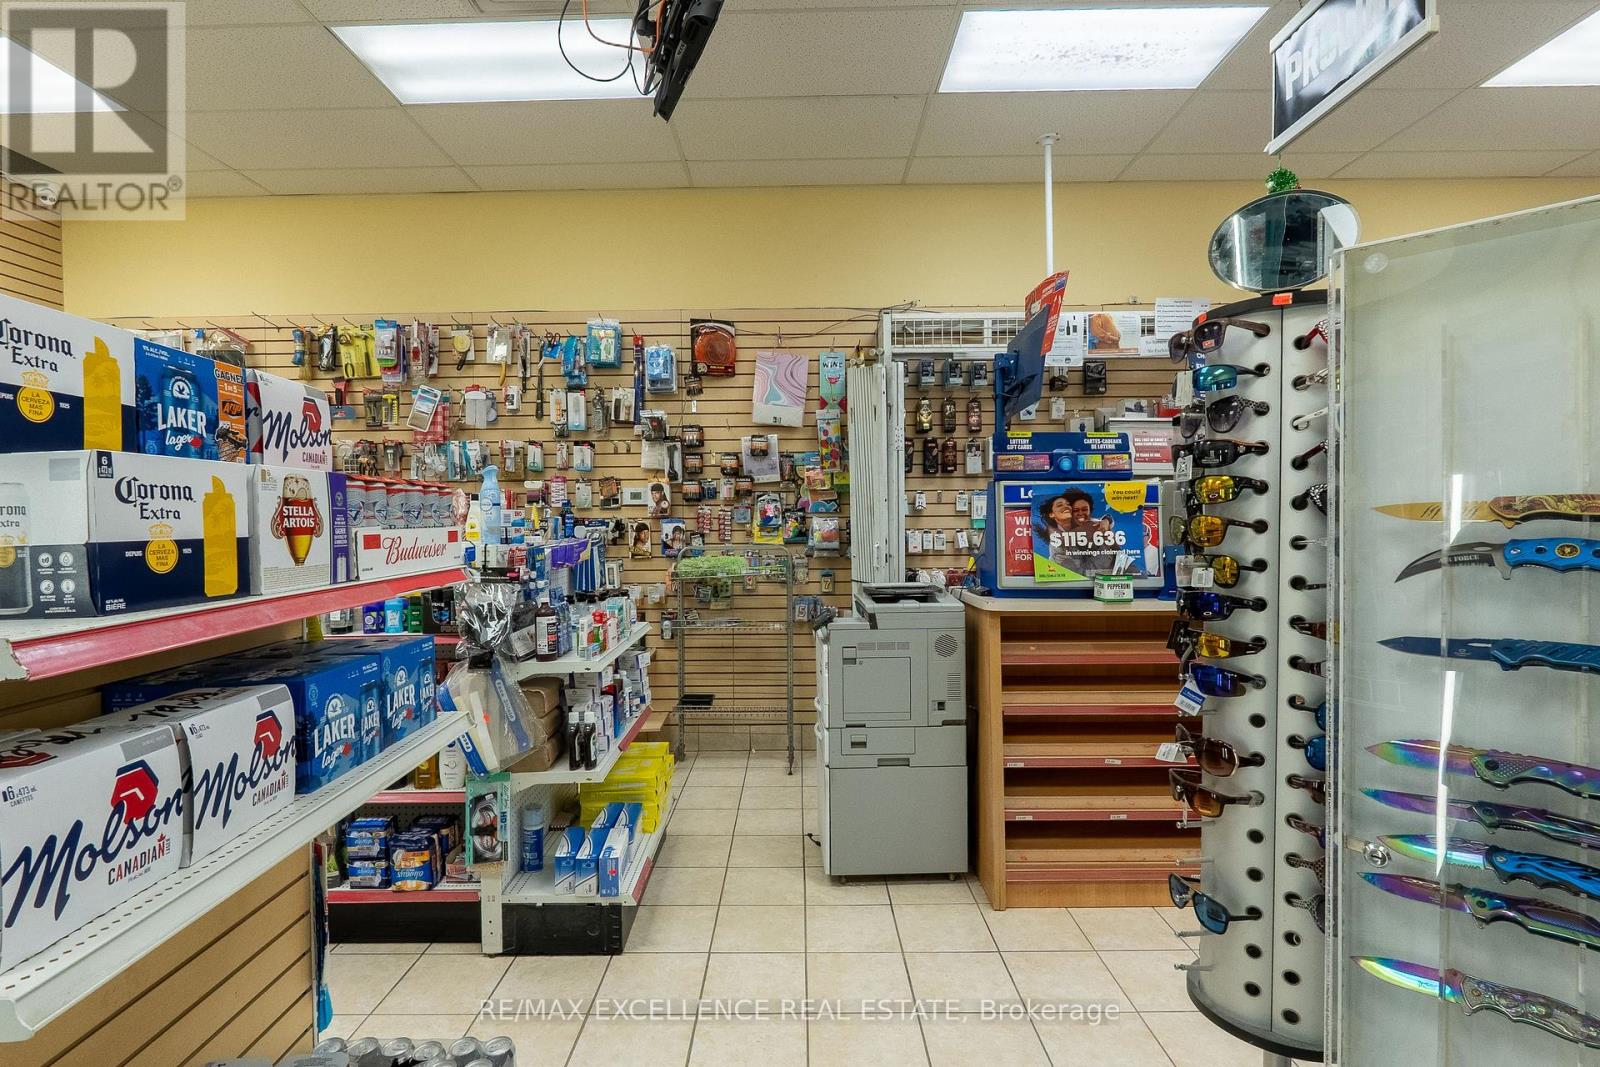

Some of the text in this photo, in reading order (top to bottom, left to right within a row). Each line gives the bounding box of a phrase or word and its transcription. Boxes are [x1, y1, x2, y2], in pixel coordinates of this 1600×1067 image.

[11, 346, 58, 372] Extra
[214, 368, 245, 385] GAGNEZ
[21, 396, 50, 405] CERVEZA
[157, 403, 207, 438] LAKER
[166, 430, 195, 451] lager
[262, 409, 332, 464] Molson
[101, 456, 108, 465] 6
[302, 451, 325, 465] CANADIAN
[115, 475, 194, 508] Corona
[0, 505, 26, 516] rona
[139, 502, 181, 520] Extra
[282, 506, 314, 516] STELLA
[0, 519, 20, 528] xtra
[282, 517, 315, 528] ARTOIS
[382, 536, 447, 565] Budweiser
[1050, 530, 1126, 549] $115,636
[1072, 549, 1100, 557] winnings
[387, 683, 416, 720] LAKER
[420, 683, 434, 703] LAKER
[361, 711, 380, 736] LAKER
[313, 714, 356, 758] LAKER
[321, 744, 345, 769] lager
[193, 735, 297, 830] Molson
[252, 775, 286, 807] CANADIAN
[1, 787, 183, 928] Molson
[108, 840, 165, 886] CANADIAN
